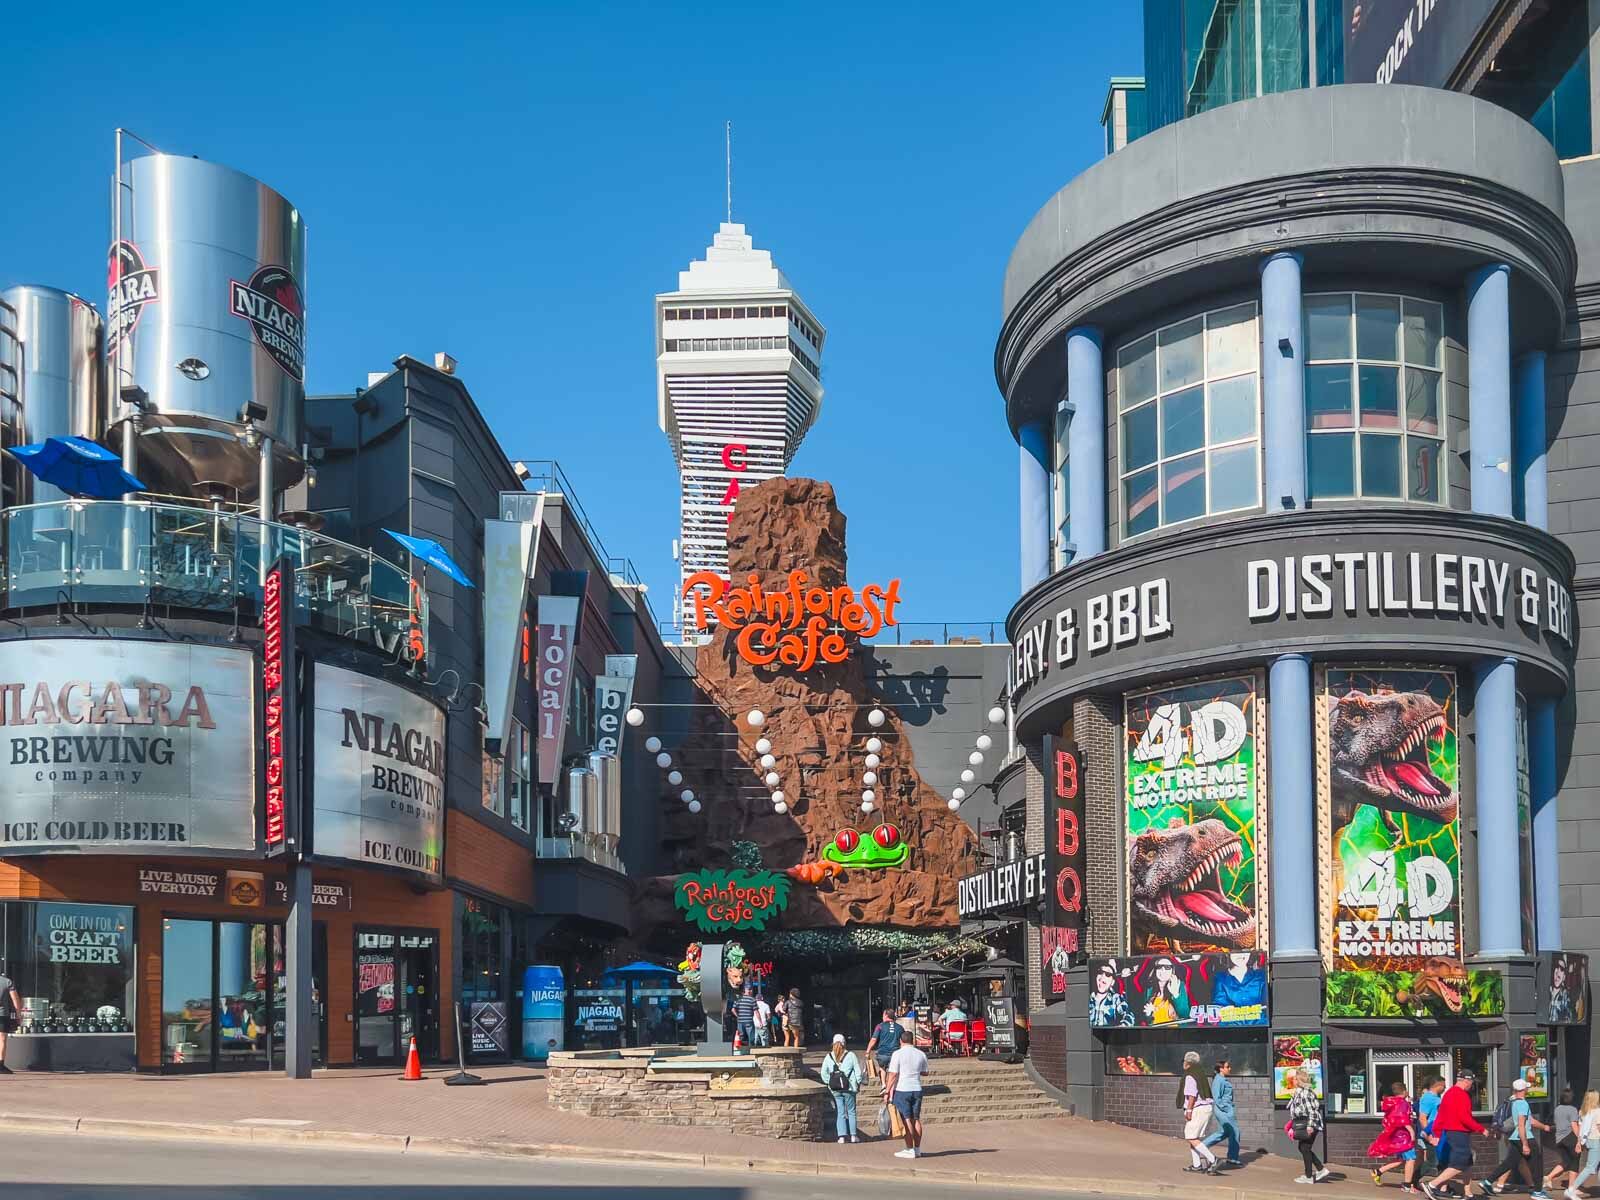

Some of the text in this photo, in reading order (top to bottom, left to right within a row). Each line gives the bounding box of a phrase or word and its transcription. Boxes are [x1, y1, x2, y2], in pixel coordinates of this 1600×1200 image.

[1376, 7, 1414, 85] ROCK
[236, 287, 305, 352] NIAGA
[682, 570, 902, 637] Rainforest
[1247, 551, 1573, 648] DISTILLERY & BB
[1056, 608, 1075, 664] &
[1087, 578, 1172, 651] BBQ
[737, 616, 849, 672] Cafe
[10, 735, 176, 766] BREWING
[341, 708, 445, 782] NIAGAR
[1133, 701, 1247, 771] 4D
[35, 768, 143, 784] company
[371, 765, 442, 811] BREWING
[1133, 763, 1247, 795] EXTREME
[1133, 783, 1247, 810] MOTION RIDE
[4, 821, 187, 842] ICE COLD BEER
[1056, 751, 1082, 913] BBQ
[365, 840, 392, 861] ICE
[395, 846, 425, 870] COLD
[139, 870, 218, 886] LIVE MUSIC
[141, 881, 216, 896] EVERYDAY
[313, 885, 344, 896] BEER
[959, 861, 1021, 915] DISTILLERY
[1025, 858, 1034, 898] &
[1338, 852, 1454, 920] 4D
[683, 881, 775, 909] Rainforest
[50, 915, 77, 930] COME
[80, 915, 93, 930] IN
[96, 916, 113, 930] FOR
[707, 900, 753, 924] Cafe
[50, 929, 120, 946] CRAFT
[1338, 921, 1455, 941] EXTREME
[50, 945, 120, 963] BEER
[1338, 940, 1456, 957] MOTION RIDE
[578, 1006, 623, 1021] NIAGARA
